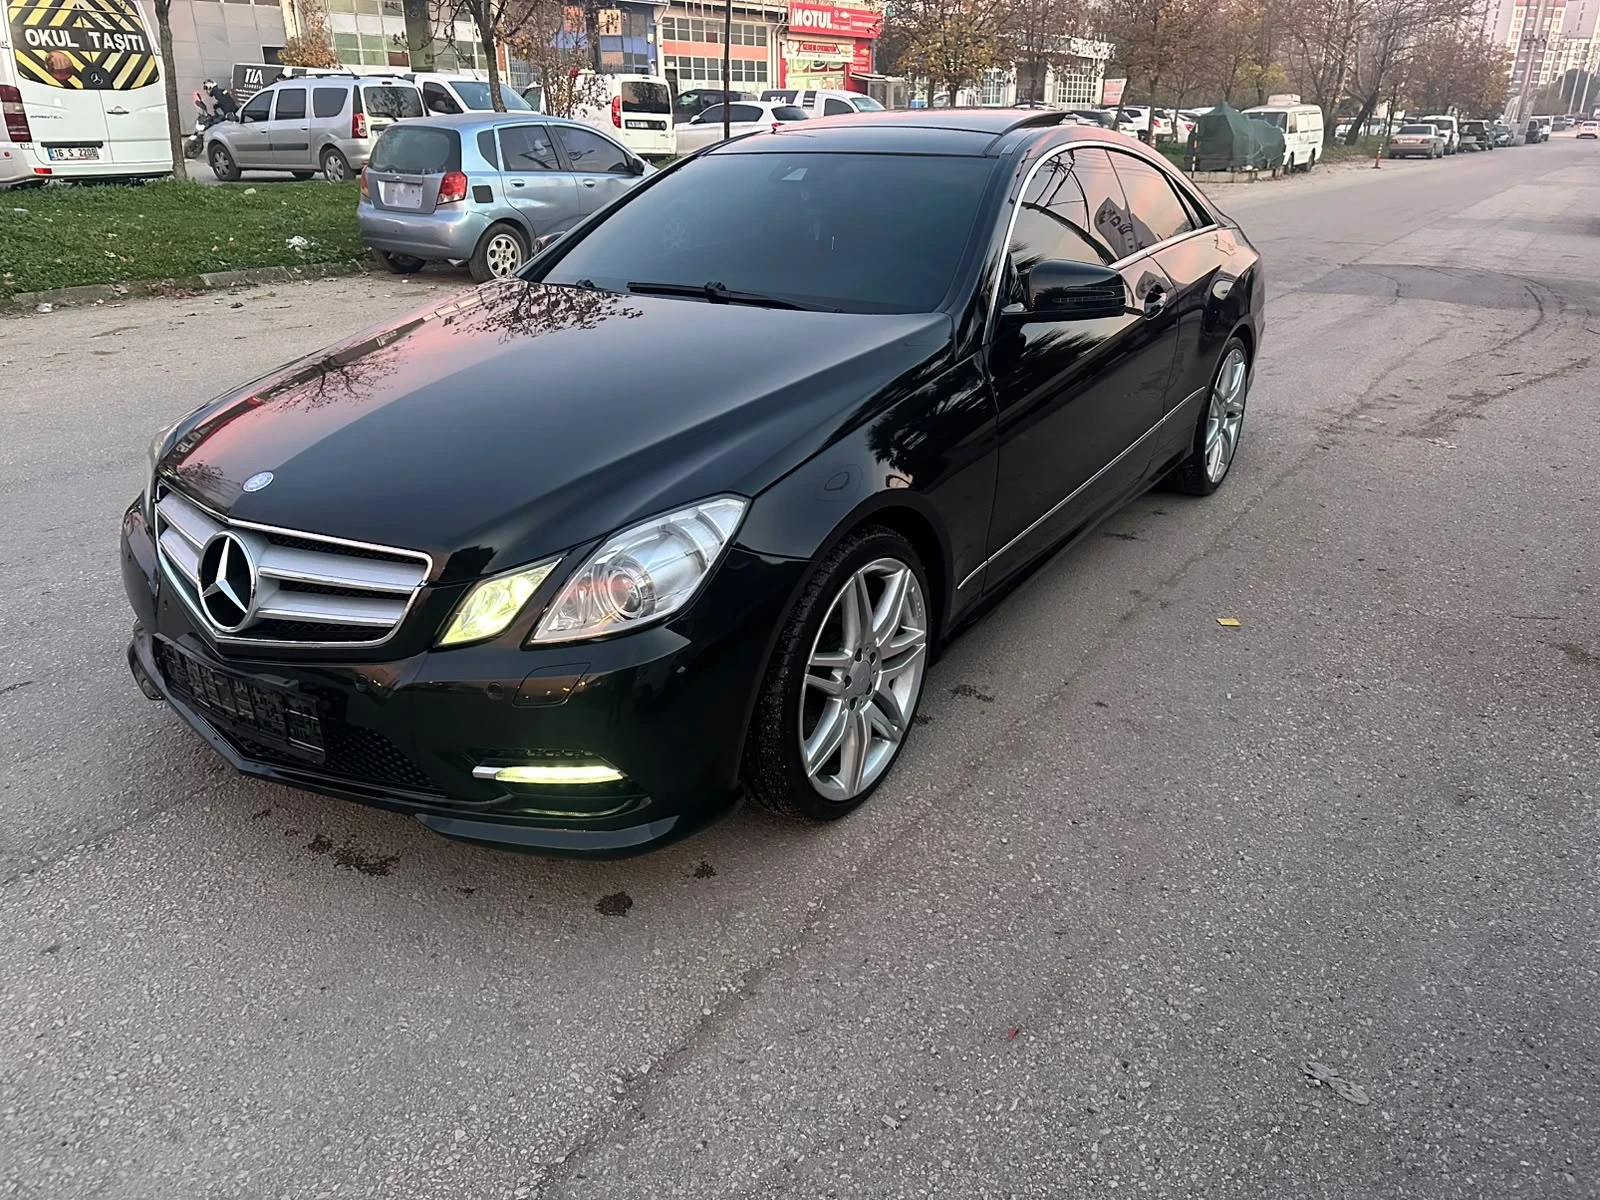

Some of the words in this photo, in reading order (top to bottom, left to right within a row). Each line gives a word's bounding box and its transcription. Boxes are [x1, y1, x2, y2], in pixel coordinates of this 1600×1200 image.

[791, 8, 833, 29] MOTUL
[25, 28, 80, 48] OKUL
[87, 31, 145, 53] TAŞITI
[54, 149, 64, 158] 16
[67, 148, 74, 157] S
